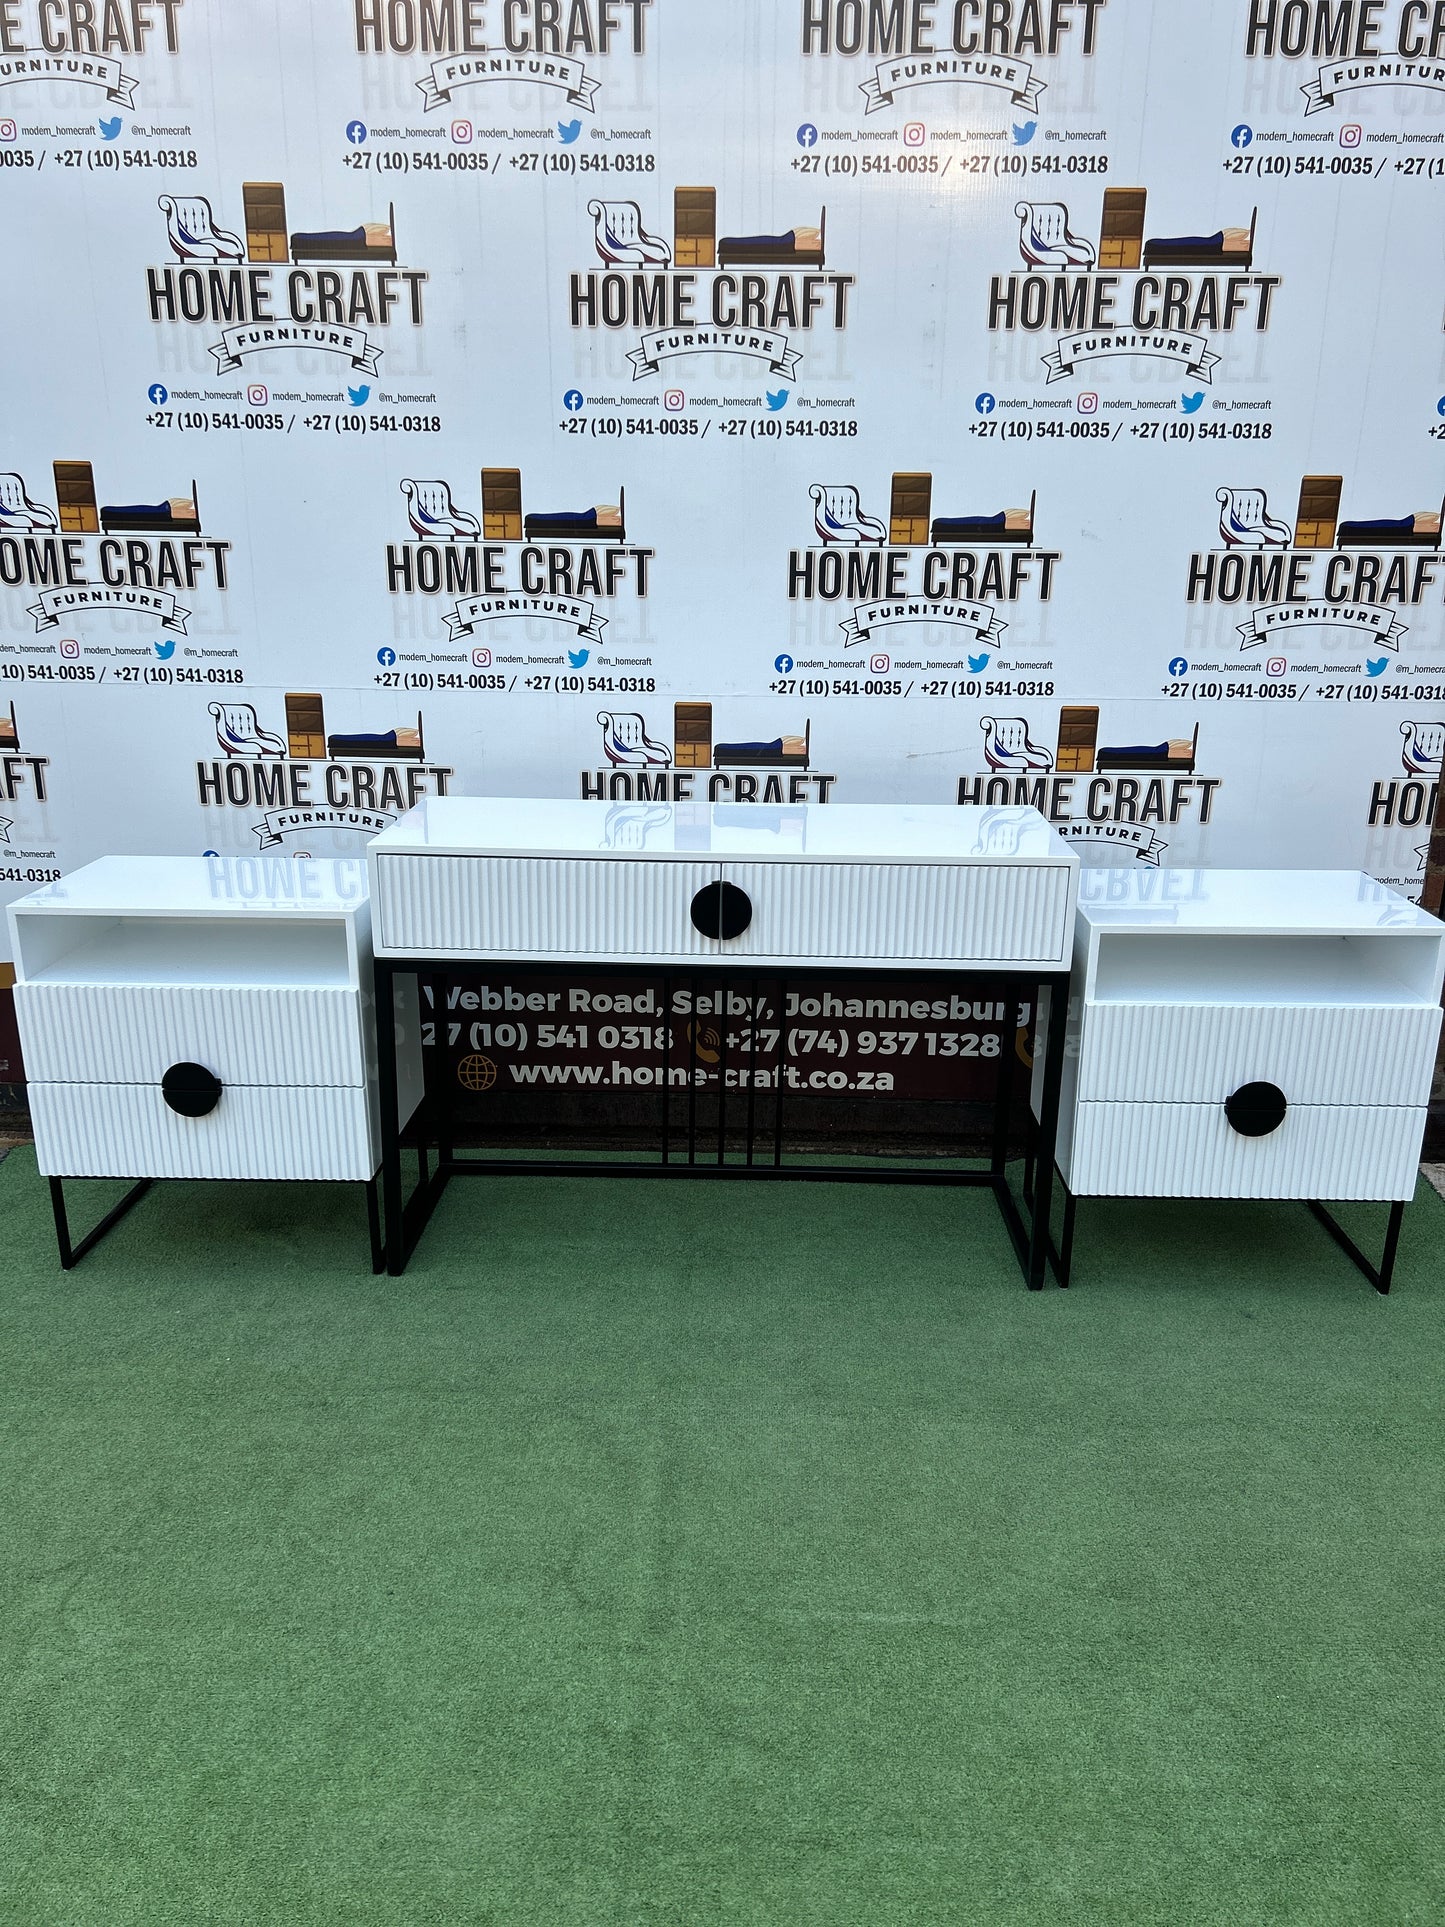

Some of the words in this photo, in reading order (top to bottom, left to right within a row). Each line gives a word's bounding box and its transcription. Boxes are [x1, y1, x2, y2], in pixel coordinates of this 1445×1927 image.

[39, 0, 183, 54] CRAFT
[355, 0, 488, 53] HOME
[503, 0, 651, 54] CRAFT
[801, 0, 935, 54] HOME
[952, 0, 1103, 55] CRAFT
[1245, 0, 1385, 57] HOME
[446, 59, 570, 81] FURNITURE
[891, 61, 1017, 82] FURNITURE
[131, 125, 191, 137] @m_homecraft
[590, 128, 651, 141] @m_homecraft
[1045, 130, 1107, 142] @m_homecraft
[54, 150, 82, 167] +27
[87, 150, 119, 171] (10)
[123, 150, 197, 168] 541-0318
[342, 152, 372, 169] +27
[376, 152, 409, 174] (10)
[413, 152, 488, 170] 541-0035
[509, 153, 539, 171] +27
[543, 154, 576, 175] (10)
[580, 154, 655, 172] 541-0318
[791, 155, 821, 173] +27
[825, 155, 857, 177] (10)
[861, 155, 938, 173] 541-0035
[960, 155, 991, 173] +27
[994, 155, 1027, 177] (10)
[1031, 155, 1108, 173] 541-0318
[1223, 156, 1254, 173] +27
[1257, 156, 1291, 178] (10)
[1294, 156, 1373, 174] 541-0035
[1394, 158, 1425, 175] +27
[146, 268, 274, 323] HOME
[287, 271, 428, 325] CRAFT
[570, 273, 696, 327] HOME
[712, 275, 854, 329] CRAFT
[987, 276, 1118, 330] HOME
[1132, 276, 1280, 330] CRAFT
[236, 329, 353, 348] FURNITURE
[655, 333, 774, 352] FURNITURE
[1072, 335, 1193, 355] FURNITURE
[379, 393, 436, 404] @m_homecraft
[797, 397, 855, 408] @m_homecraft
[1212, 400, 1271, 411] @m_homecraft
[146, 412, 173, 427] +27
[178, 412, 208, 432] (10)
[212, 413, 284, 430] 541-0035
[303, 415, 331, 430] +27
[335, 415, 366, 434] (10)
[370, 415, 441, 432] 541-0318
[559, 418, 587, 434] +27
[591, 418, 622, 438] (10)
[626, 419, 698, 435] 541-0035
[718, 420, 747, 435] +27
[751, 420, 782, 439] (10)
[785, 420, 857, 436] 541-0318
[969, 421, 998, 437] +27
[1001, 421, 1032, 441] (10)
[1036, 422, 1110, 438] 541-0035
[1130, 422, 1159, 438] +27
[1163, 423, 1194, 442] (10)
[1198, 423, 1272, 439] 541-0318
[99, 539, 230, 589] CRAFT
[386, 545, 507, 594] HOME
[520, 547, 654, 596] CRAFT
[788, 551, 909, 599] HOME
[923, 551, 1060, 600] CRAFT
[1186, 554, 1313, 603] HOME
[1324, 555, 1445, 604] CRAF
[53, 591, 162, 609] FURNITURE
[469, 599, 581, 617] FURNITURE
[868, 604, 980, 622] FURNITURE
[1266, 607, 1381, 625] FURNITURE
[184, 648, 238, 658] @m_homecraft
[597, 656, 652, 667] @m_homecraft
[1, 664, 25, 682] 10)
[28, 665, 95, 680] 541-0035
[113, 667, 140, 681] +27
[144, 667, 173, 685] (10)
[176, 668, 243, 683] 541-0318
[997, 660, 1053, 671] @m_homecraft
[374, 672, 400, 687] +27
[404, 673, 434, 691] (10)
[437, 674, 505, 689] 541-0035
[524, 676, 551, 690] +27
[555, 676, 584, 694] (10)
[588, 677, 655, 692] 541-0318
[769, 680, 796, 694] +27
[800, 680, 829, 697] (10)
[832, 680, 901, 695] 541-0035
[921, 681, 948, 695] +27
[951, 681, 981, 698] (10)
[985, 681, 1054, 696] 541-0318
[1161, 683, 1189, 697] +27
[1192, 683, 1222, 700] (10)
[1226, 683, 1297, 698] 541-0035
[1316, 685, 1344, 699] +27
[1347, 685, 1378, 702] (10)
[197, 762, 312, 807] HOME
[325, 765, 453, 809] CRAFT
[581, 772, 695, 802] HOME
[958, 777, 1075, 821] HOME
[1087, 778, 1220, 823] CRAFT
[278, 813, 384, 829] FURNITURE
[423, 986, 560, 1011] Webber
[568, 988, 664, 1017] Road,
[671, 990, 774, 1021] Selby,
[786, 992, 1030, 1027] Johannesburg
[470, 1022, 528, 1051] (10)
[537, 1025, 589, 1048] 541
[598, 1026, 674, 1050] 0318
[726, 1028, 780, 1052] +27
[788, 1029, 849, 1058] (74)
[857, 1031, 919, 1056] 937
[924, 1032, 1001, 1057] 1328
[509, 1061, 894, 1092] www.home-craft.co.za
